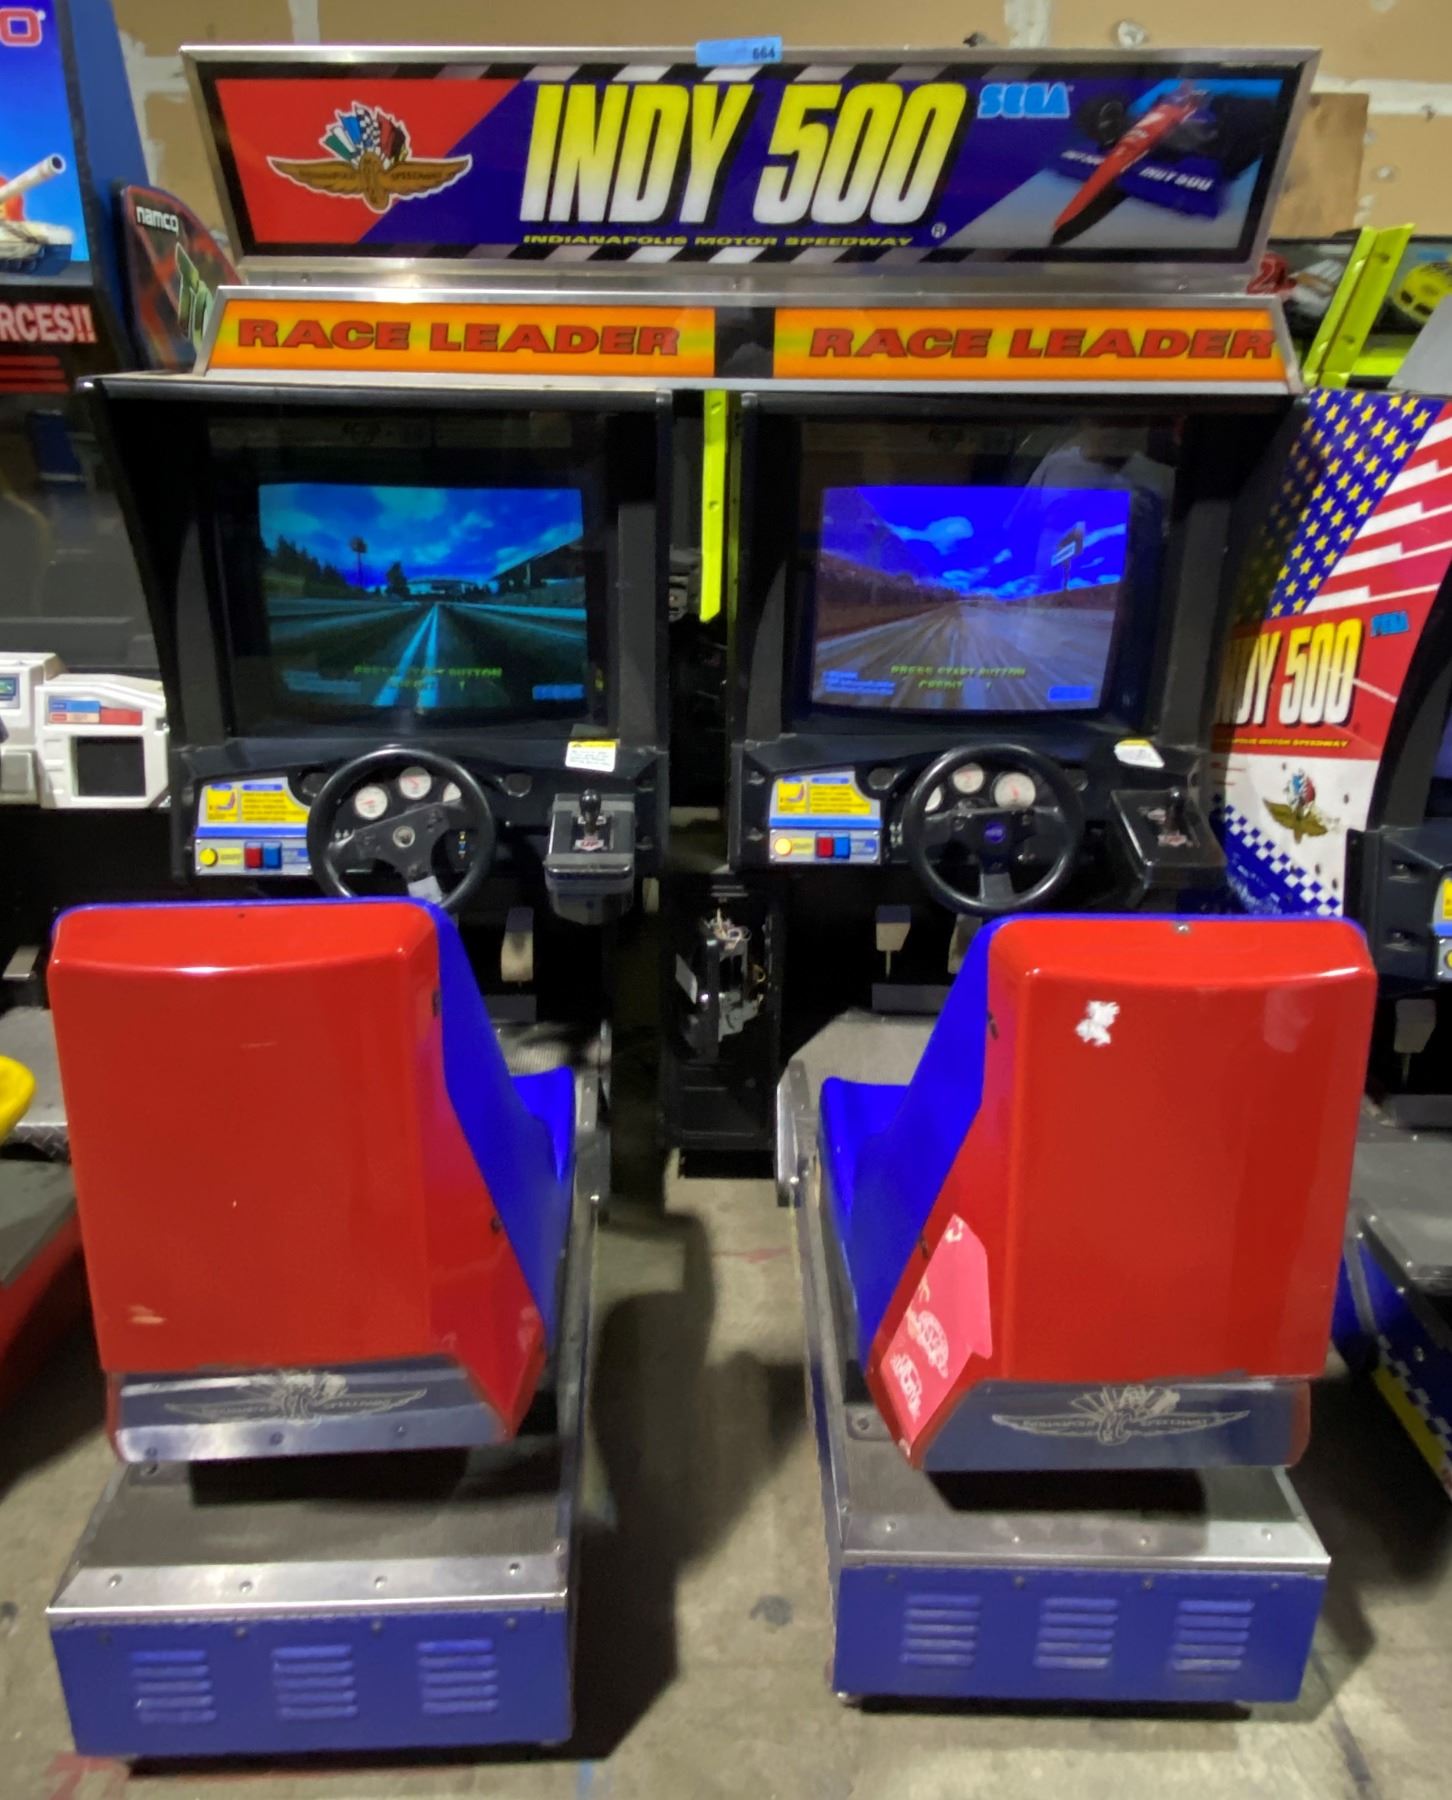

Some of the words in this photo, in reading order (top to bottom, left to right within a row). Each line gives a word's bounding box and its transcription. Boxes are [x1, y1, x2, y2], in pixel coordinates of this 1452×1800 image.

[752, 46, 775, 59] 664
[977, 82, 1070, 119] SEGA
[519, 83, 755, 224] INDY
[752, 82, 968, 225] 500
[136, 205, 179, 235] namco
[522, 235, 688, 246] INDIANAPOLIS
[694, 237, 778, 246] MOTOR
[784, 236, 913, 246] SPEEDWAY
[238, 318, 411, 351] RACE
[429, 322, 680, 357] LEADER
[809, 327, 994, 359] RACE
[1007, 328, 1276, 359] LEADER
[1278, 618, 1363, 725] 500
